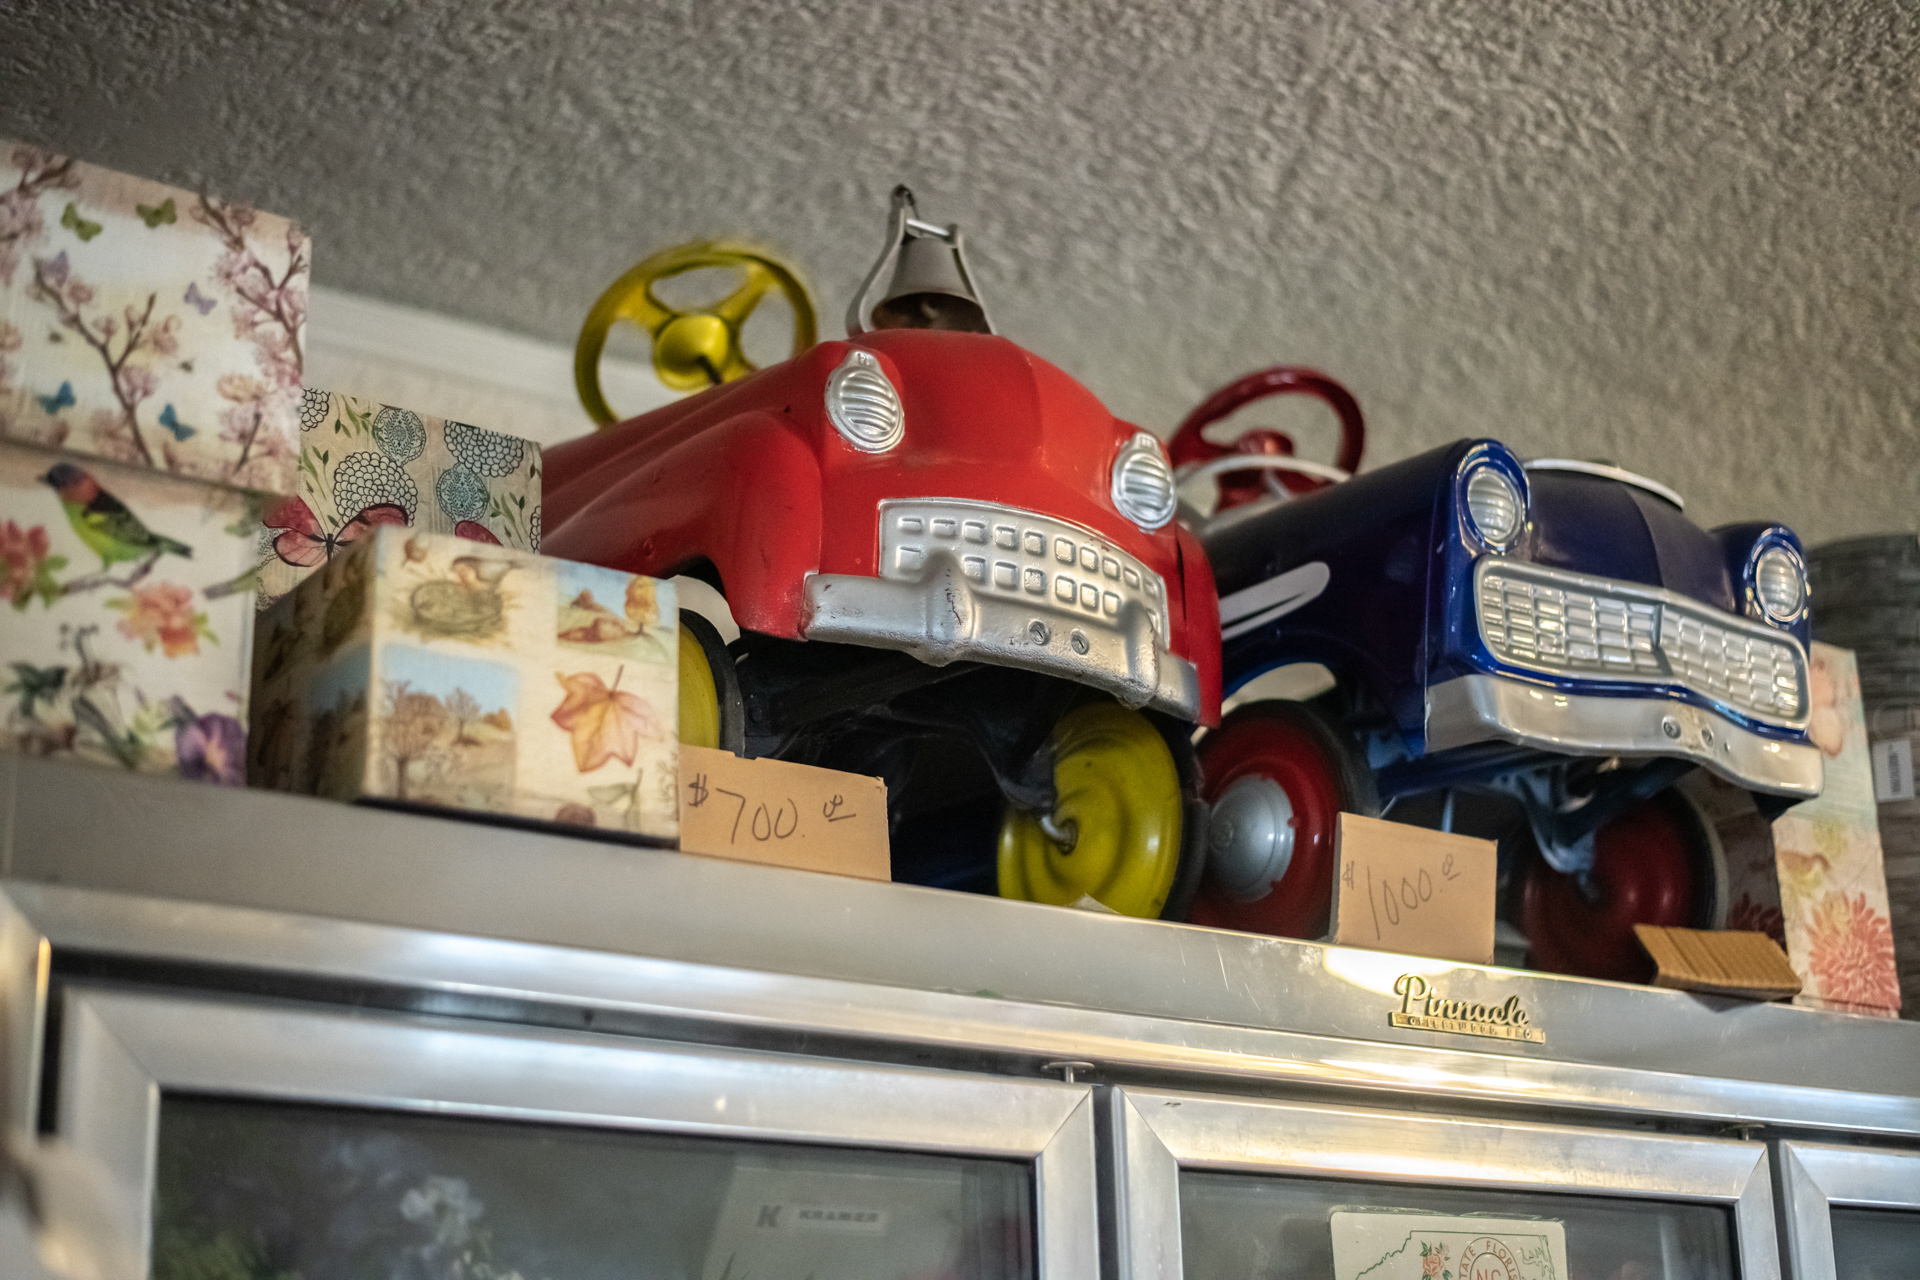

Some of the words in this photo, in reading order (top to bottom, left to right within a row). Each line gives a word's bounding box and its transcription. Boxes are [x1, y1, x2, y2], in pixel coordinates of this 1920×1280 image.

[1393, 972, 1530, 1028] Pinnacle
[756, 1204, 782, 1228] K
[1459, 1245, 1476, 1280] TATE
[1486, 1240, 1518, 1280] FLORIS
